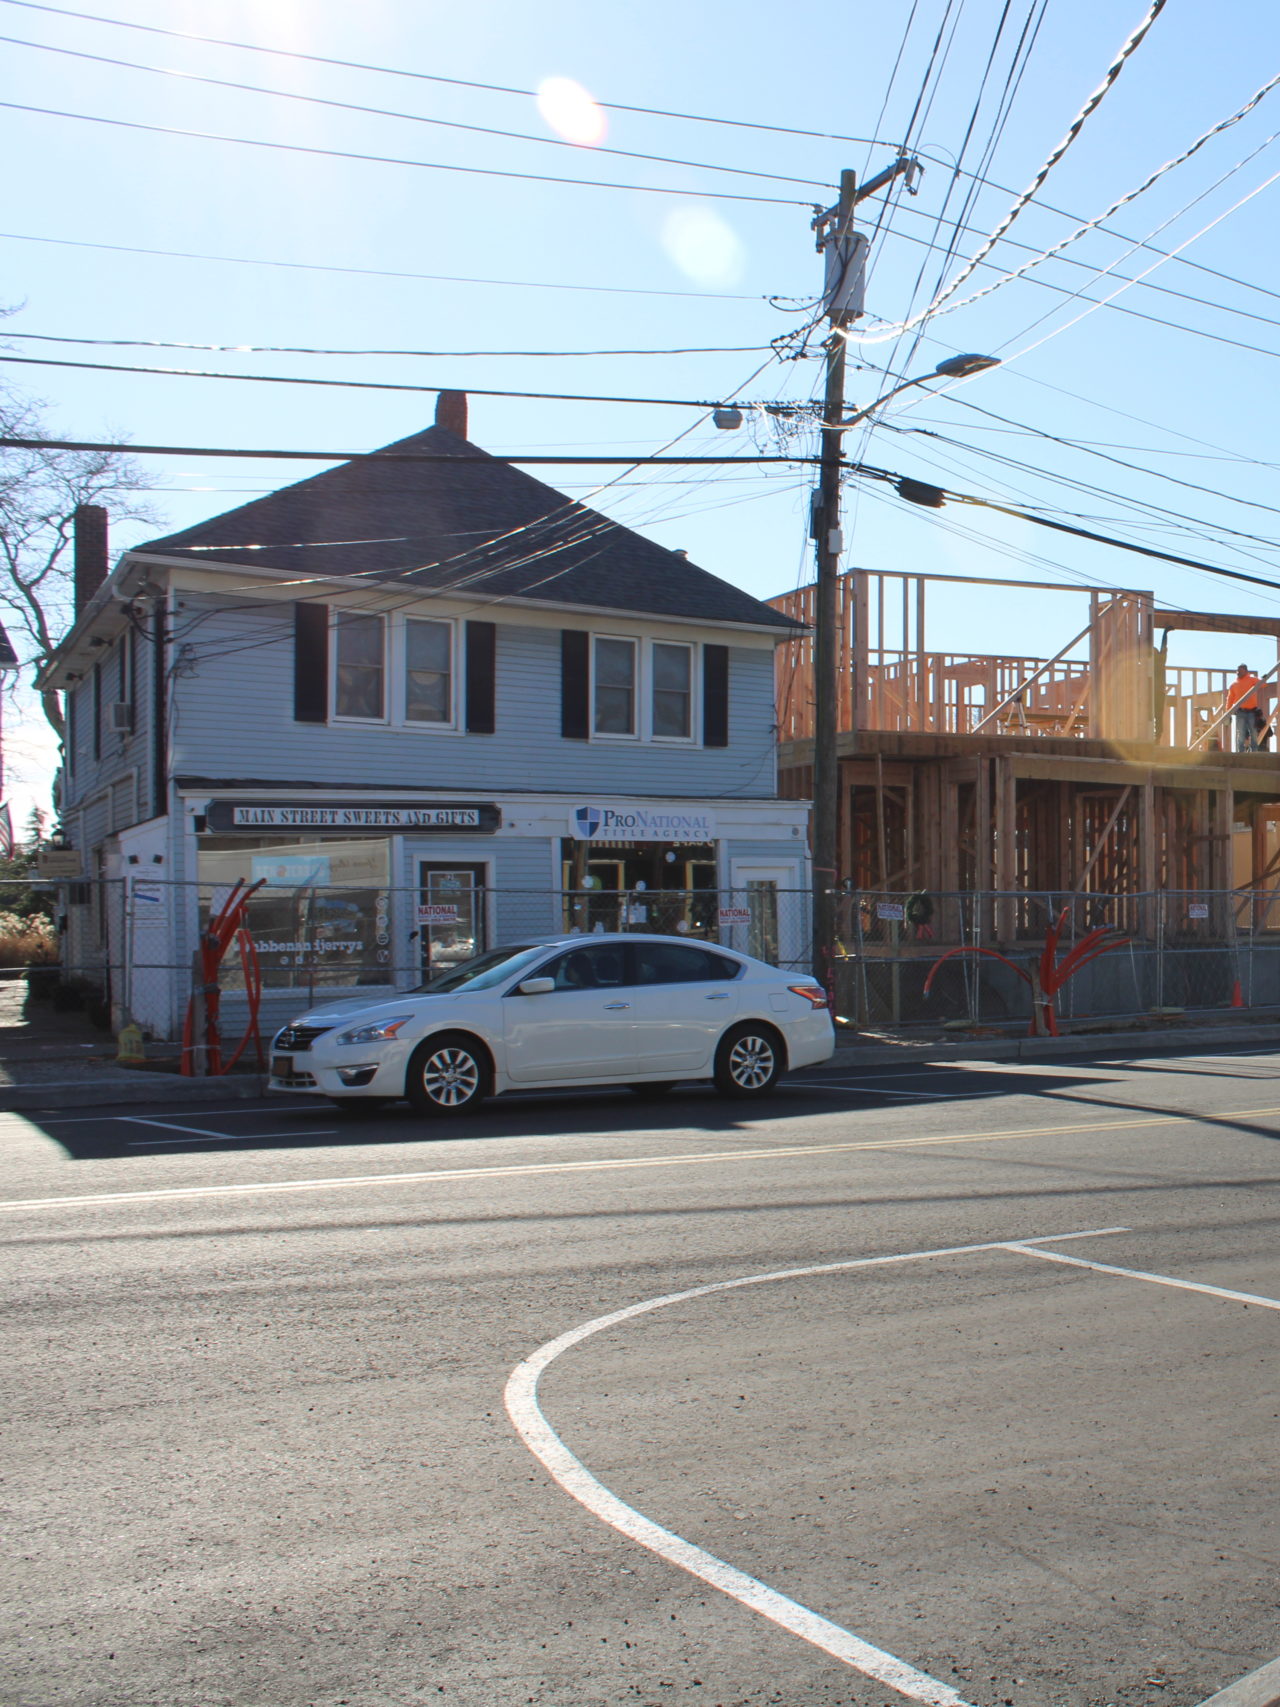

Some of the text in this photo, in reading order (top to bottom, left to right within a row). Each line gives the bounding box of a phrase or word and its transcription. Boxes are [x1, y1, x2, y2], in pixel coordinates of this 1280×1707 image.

[239, 809, 476, 825] MAIN STREET SWEETS AND GIFTS
[603, 829, 709, 838] TITLE AGENCY
[418, 905, 456, 915] NATIONAL
[720, 908, 750, 917] NATIONAL
